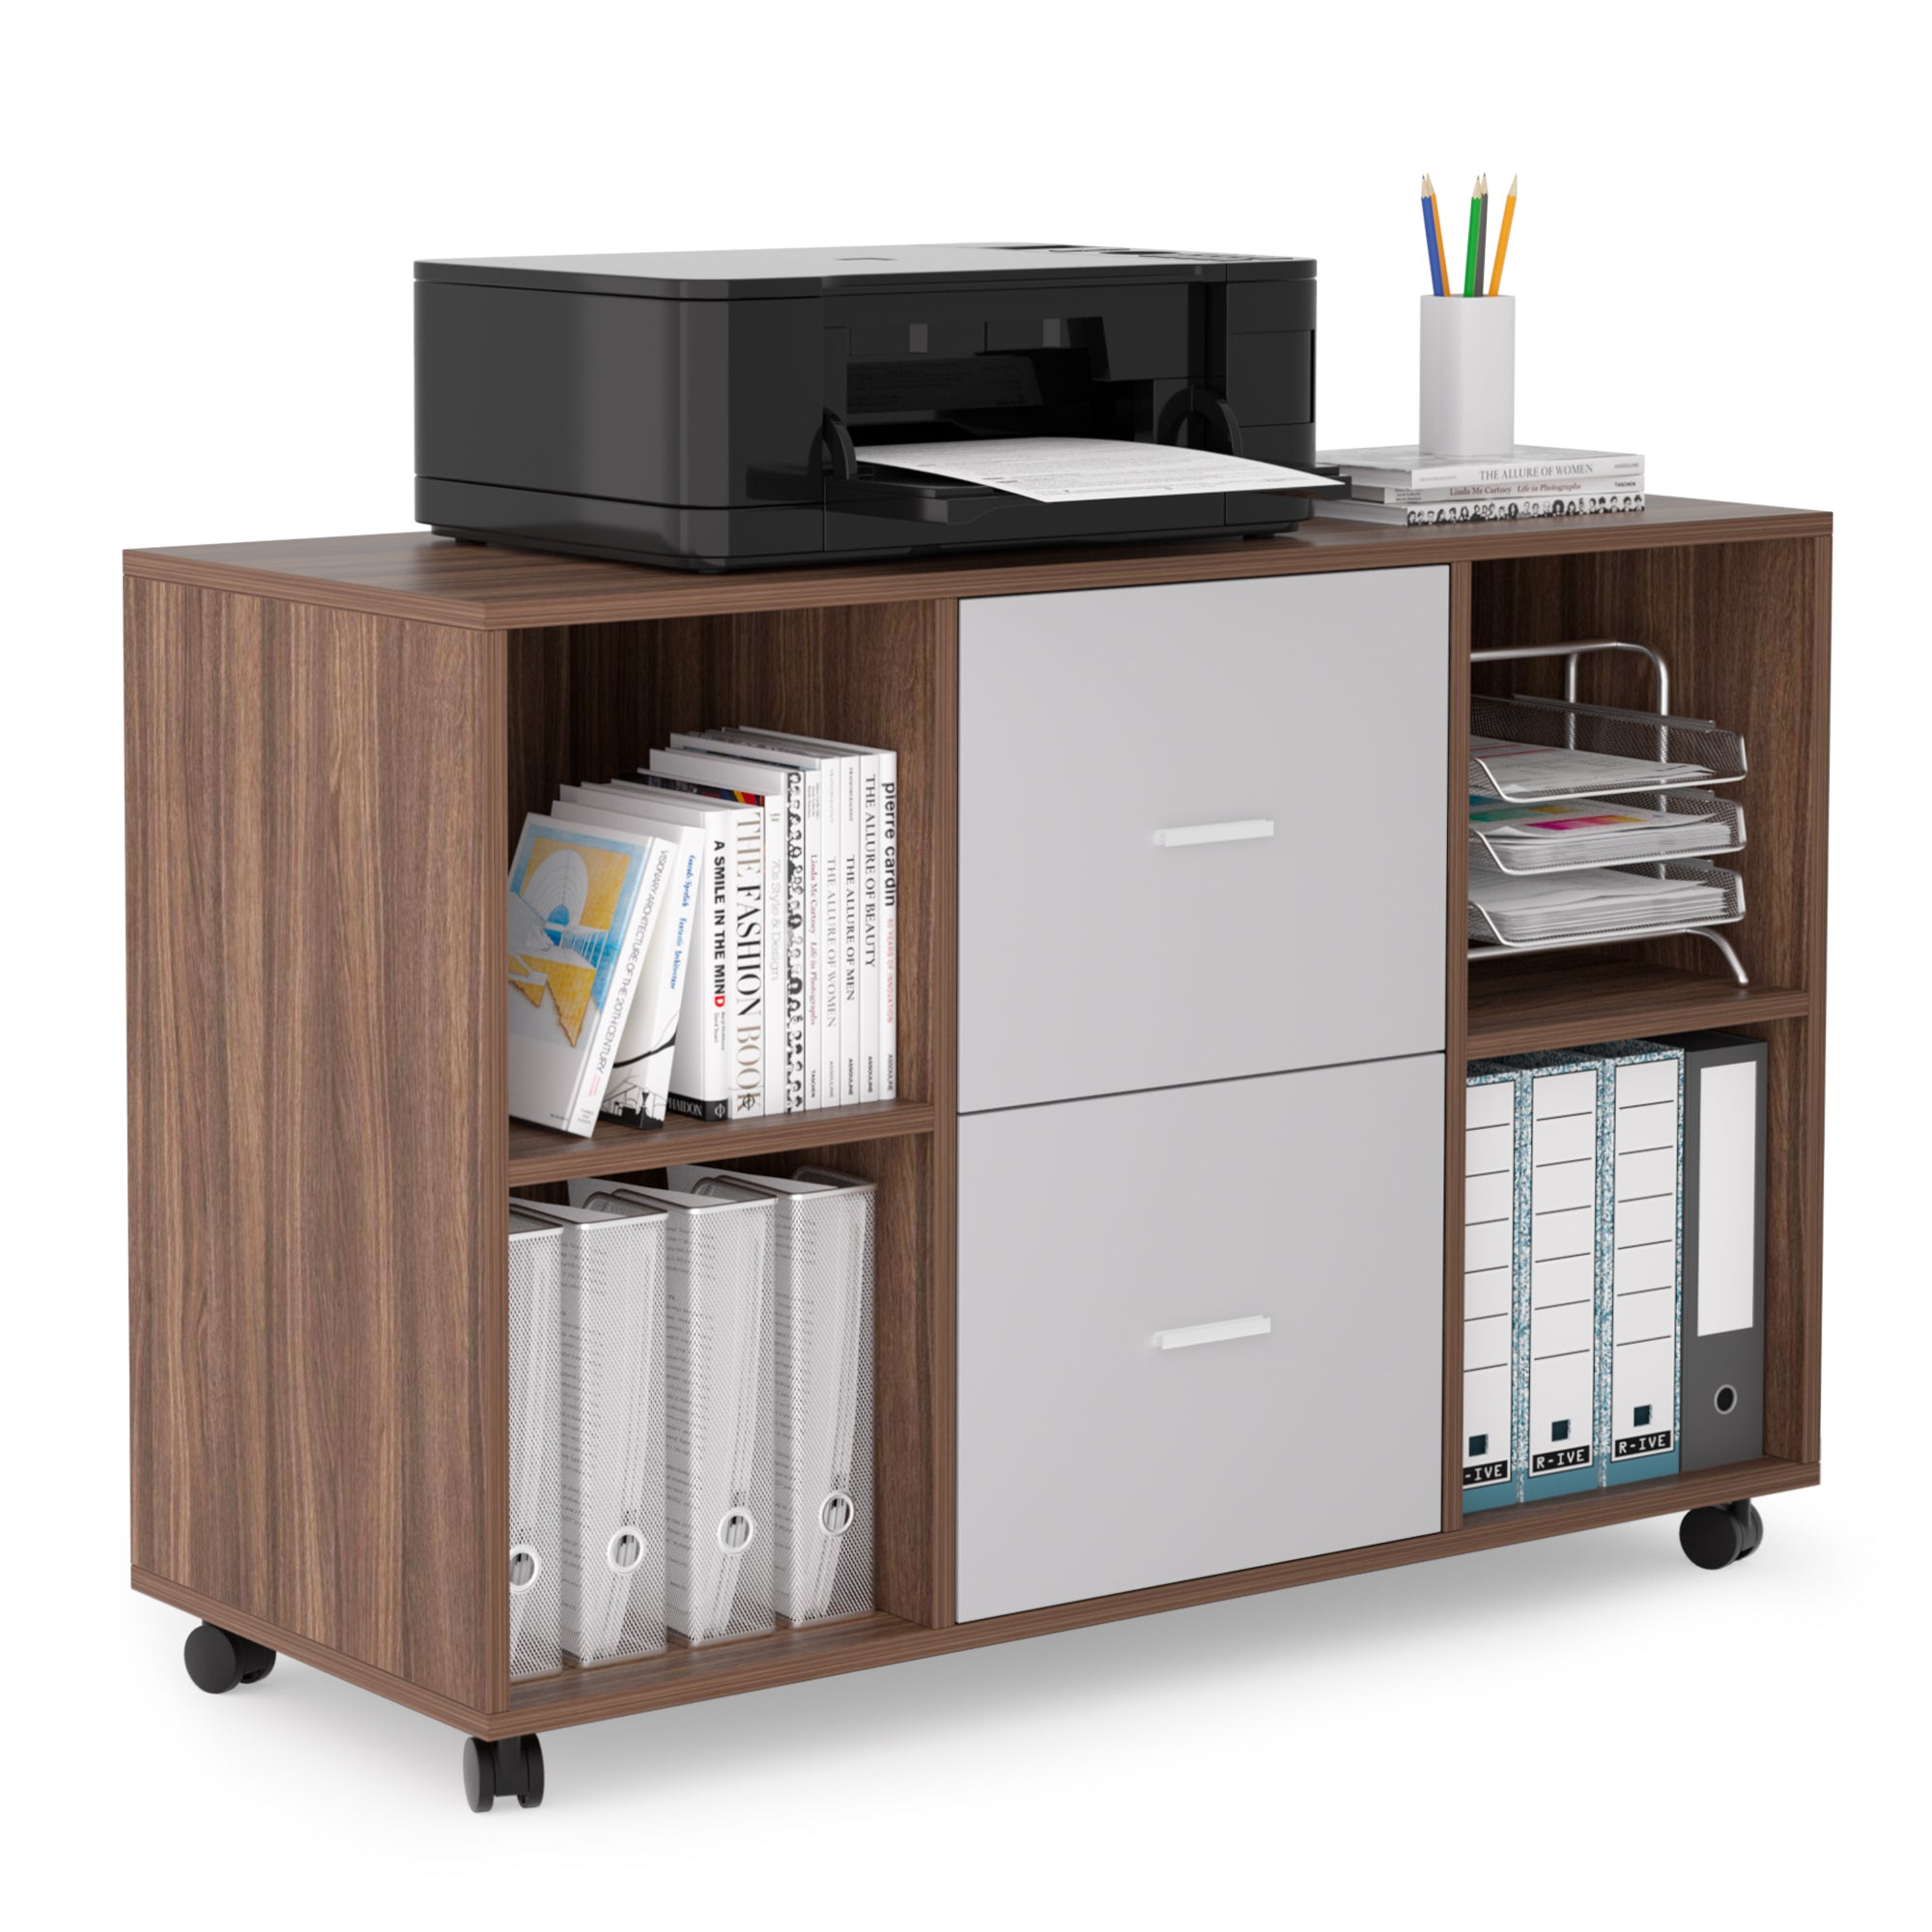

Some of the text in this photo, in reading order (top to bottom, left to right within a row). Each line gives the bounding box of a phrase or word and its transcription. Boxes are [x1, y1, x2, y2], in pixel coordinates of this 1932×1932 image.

[1480, 464, 1593, 480] THE ALLURE OF WOMEN
[1450, 487, 1470, 496] Linda
[1485, 486, 1511, 496] Cartney
[1540, 483, 1581, 493] Photographs
[714, 840, 724, 851] A
[881, 782, 896, 907] pierre cardin
[714, 856, 724, 904] SMILE
[866, 774, 876, 967] THE ALLURE OF BEAUTY
[810, 883, 817, 896] Mc
[714, 910, 724, 925] IN
[769, 859, 781, 981] 70s Style & Design
[809, 899, 817, 934] Cartney
[846, 854, 855, 1001] THE ALLURE OF MEN
[714, 931, 724, 960] THE
[827, 856, 836, 1027] THE ALLURE OF WOMEN
[596, 850, 668, 1074] VISIONARY ARCHITECTURE OF THE 20TH CENTURY
[736, 812, 761, 1113] THE FASHION BOOK
[810, 960, 817, 969] in
[886, 959, 894, 969] OF
[714, 965, 725, 1008] MIND
[809, 972, 818, 1025] Photographs
[668, 1097, 703, 1117] HAIDON
[1618, 1434, 1666, 1454] R-IVE
[1464, 1463, 1503, 1481] -IVE
[1536, 1449, 1585, 1470] R-IVE
